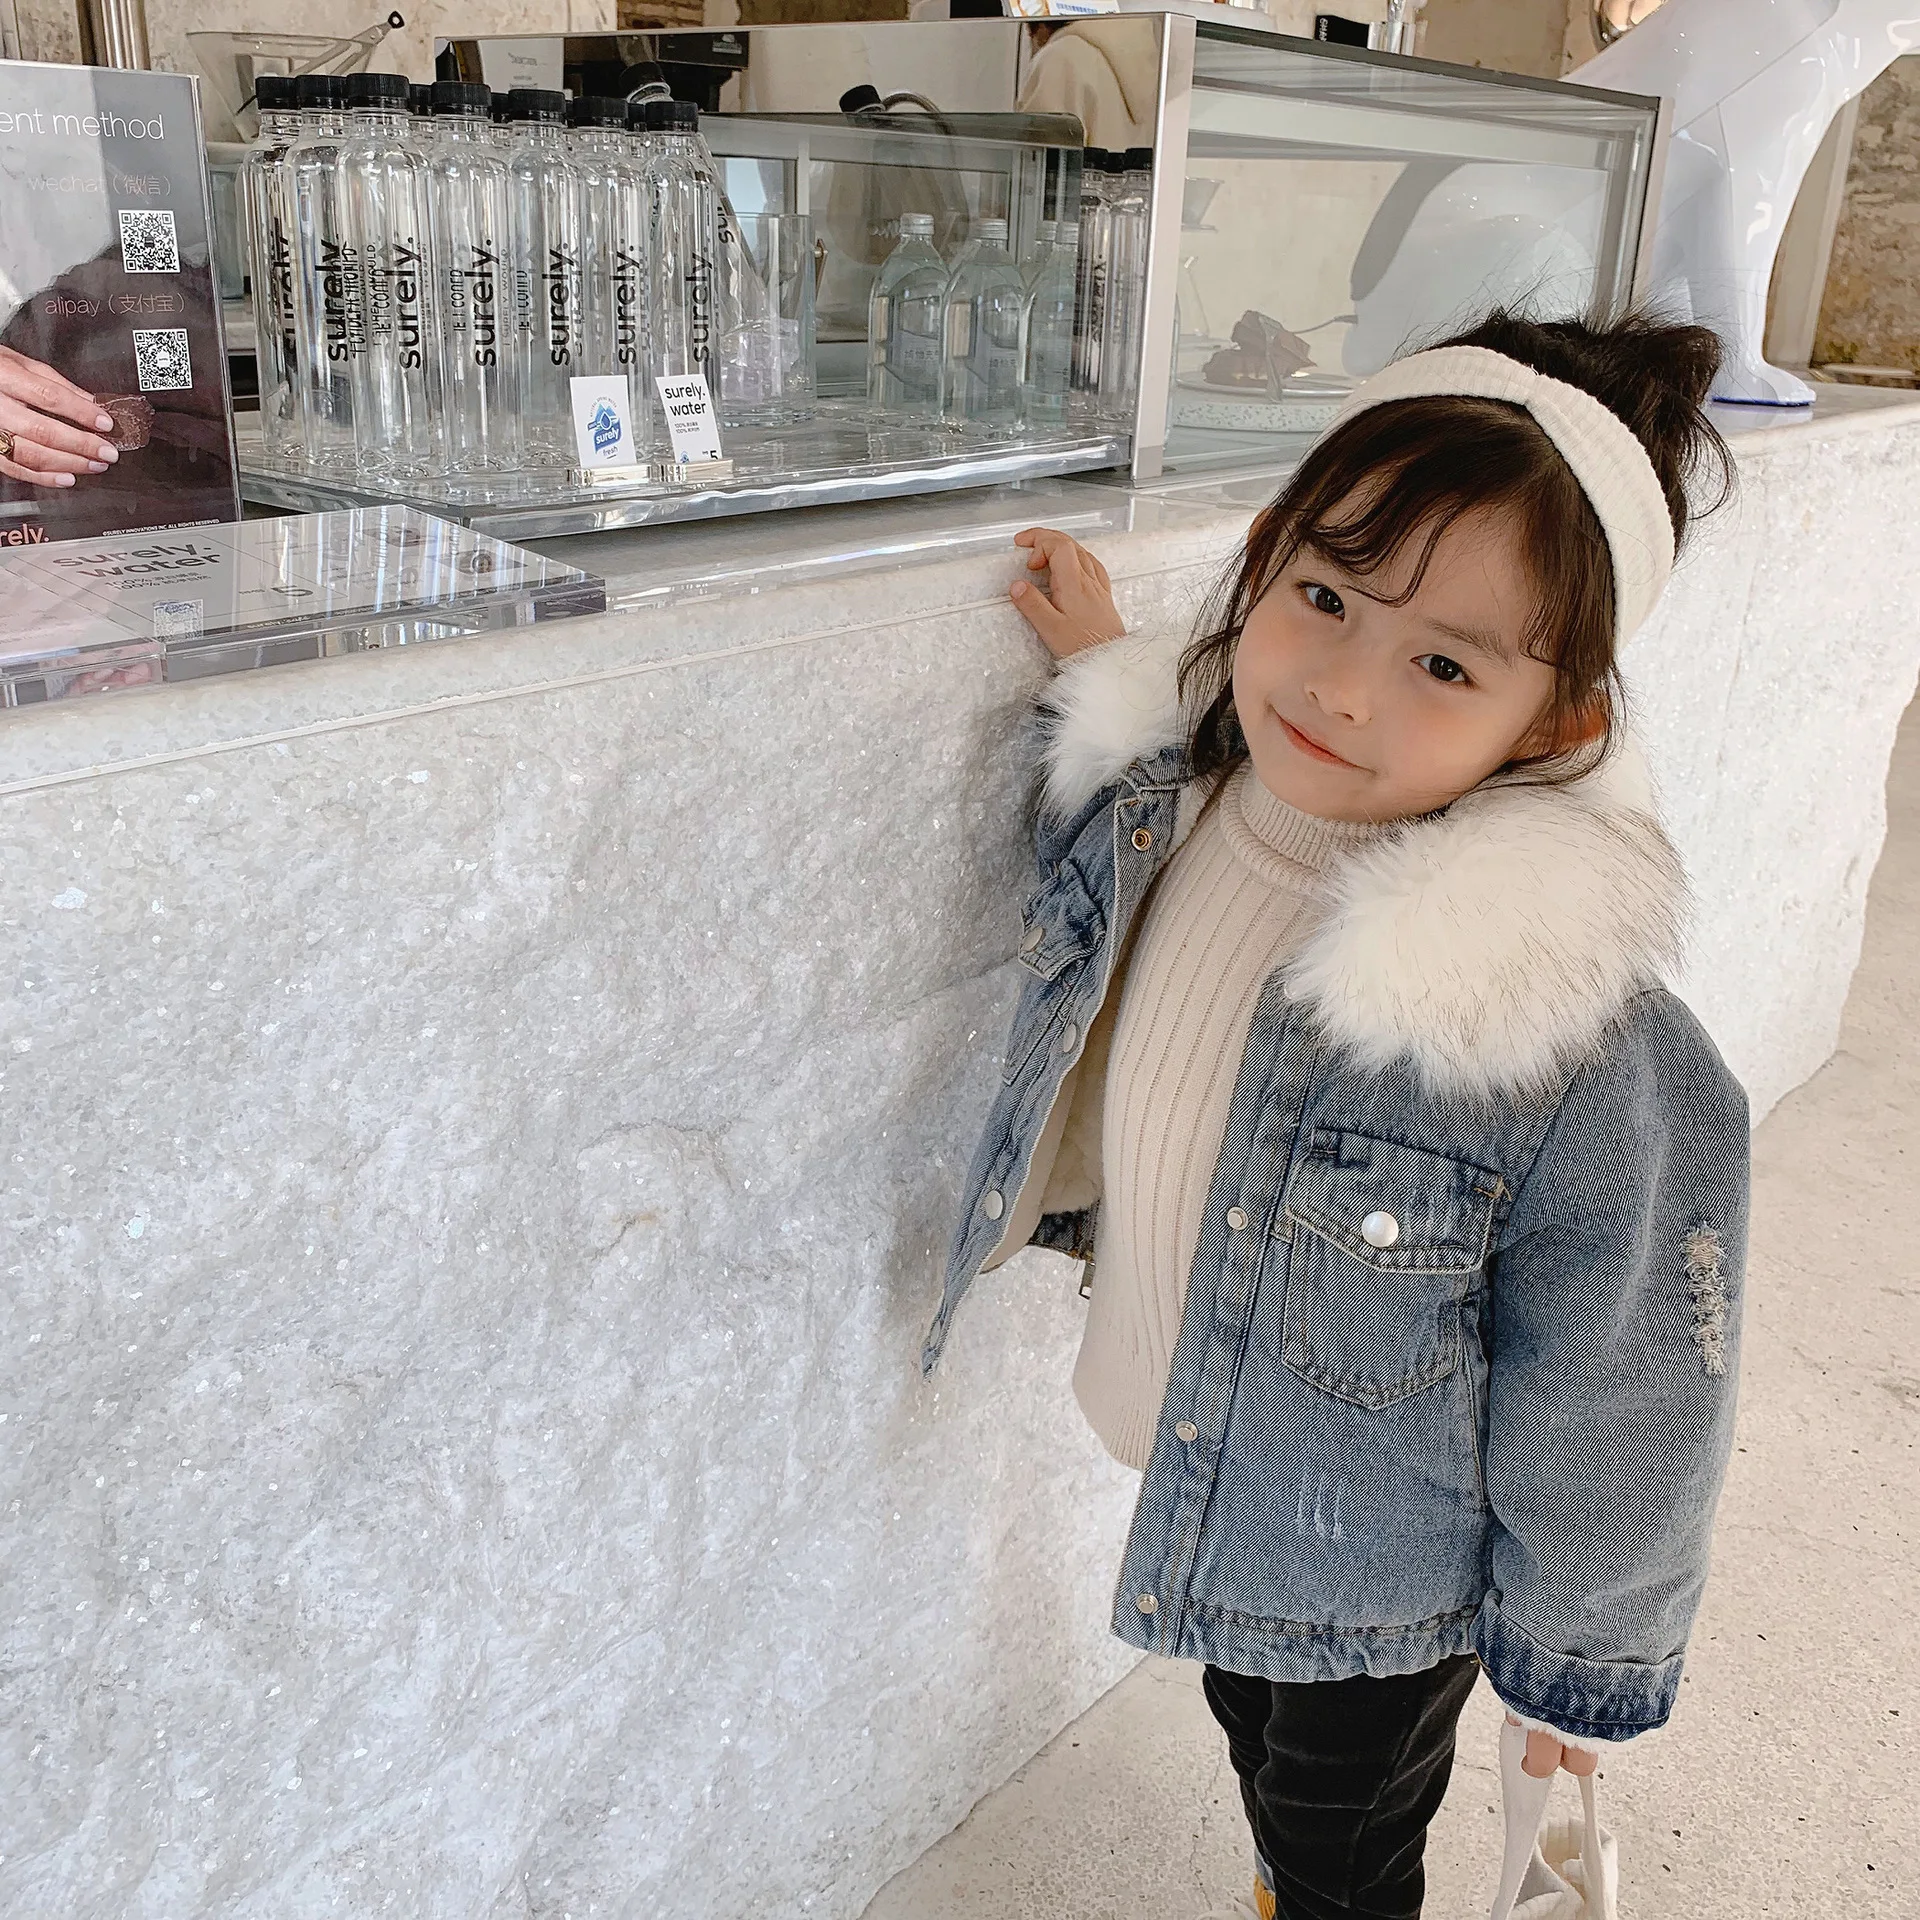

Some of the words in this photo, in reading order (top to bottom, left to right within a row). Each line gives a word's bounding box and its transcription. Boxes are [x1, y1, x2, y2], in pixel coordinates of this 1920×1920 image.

[53, 111, 165, 140] method
[45, 296, 101, 318] alipay
[385, 237, 422, 369] surely.
[464, 239, 500, 368] surely.
[542, 242, 575, 366] surely.
[609, 245, 640, 365] surely.
[685, 247, 712, 363] surely.
[664, 382, 706, 401] surely.
[669, 402, 707, 417] water
[596, 427, 620, 445] surely
[602, 445, 619, 457] fresh
[0, 523, 50, 547] rely.
[53, 543, 212, 567] surely.
[77, 553, 221, 578] water
[271, 585, 314, 597] 5
